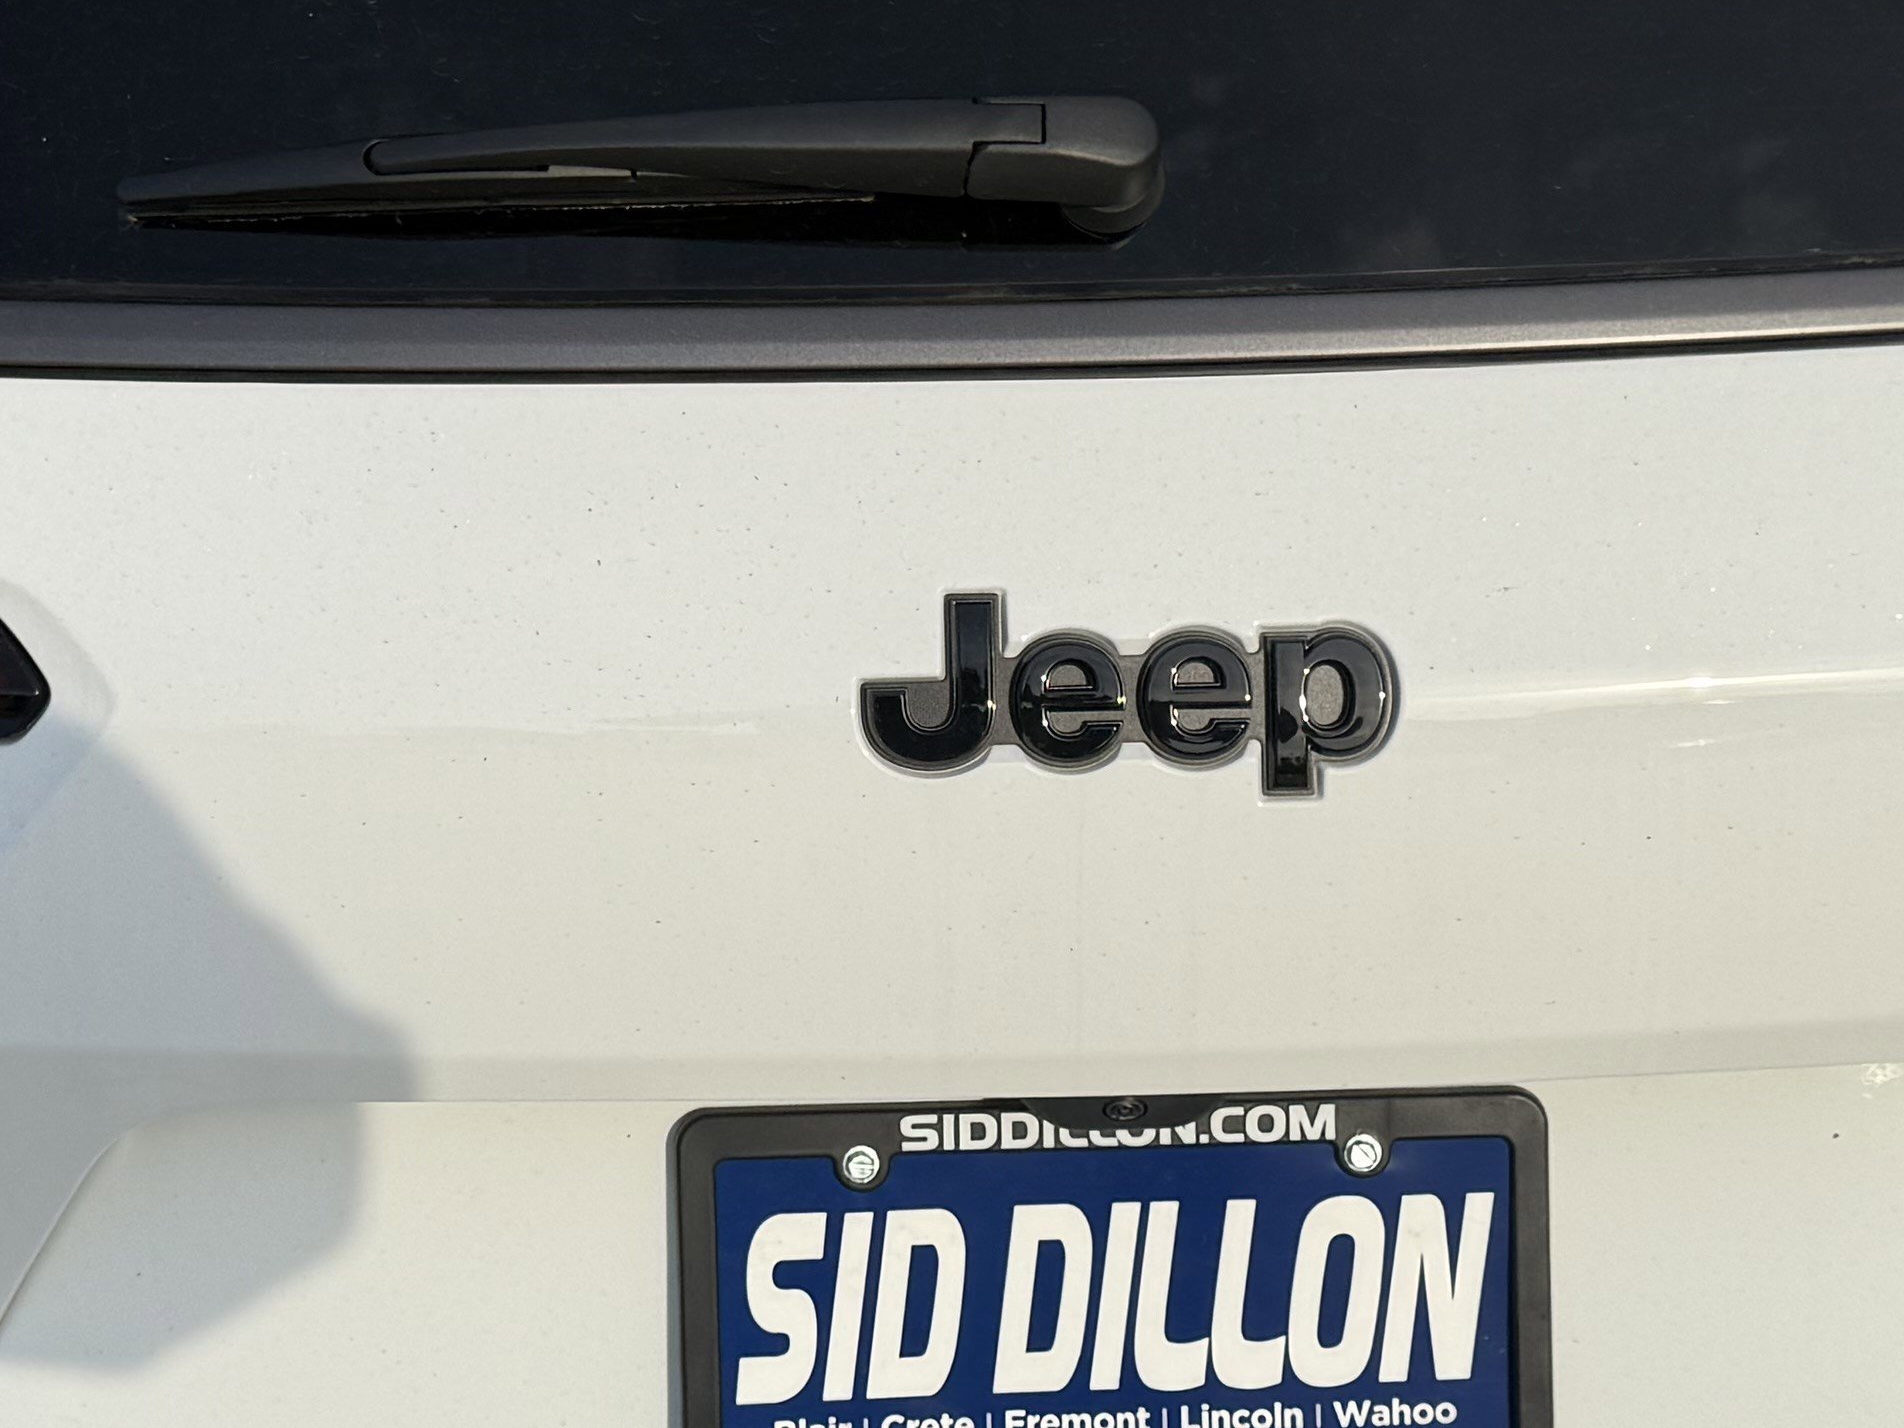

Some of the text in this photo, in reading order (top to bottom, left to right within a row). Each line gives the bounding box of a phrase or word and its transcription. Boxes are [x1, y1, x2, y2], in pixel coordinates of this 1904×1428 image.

[859, 590, 1398, 798] Jeep
[736, 1191, 1495, 1405] SID DILLON
